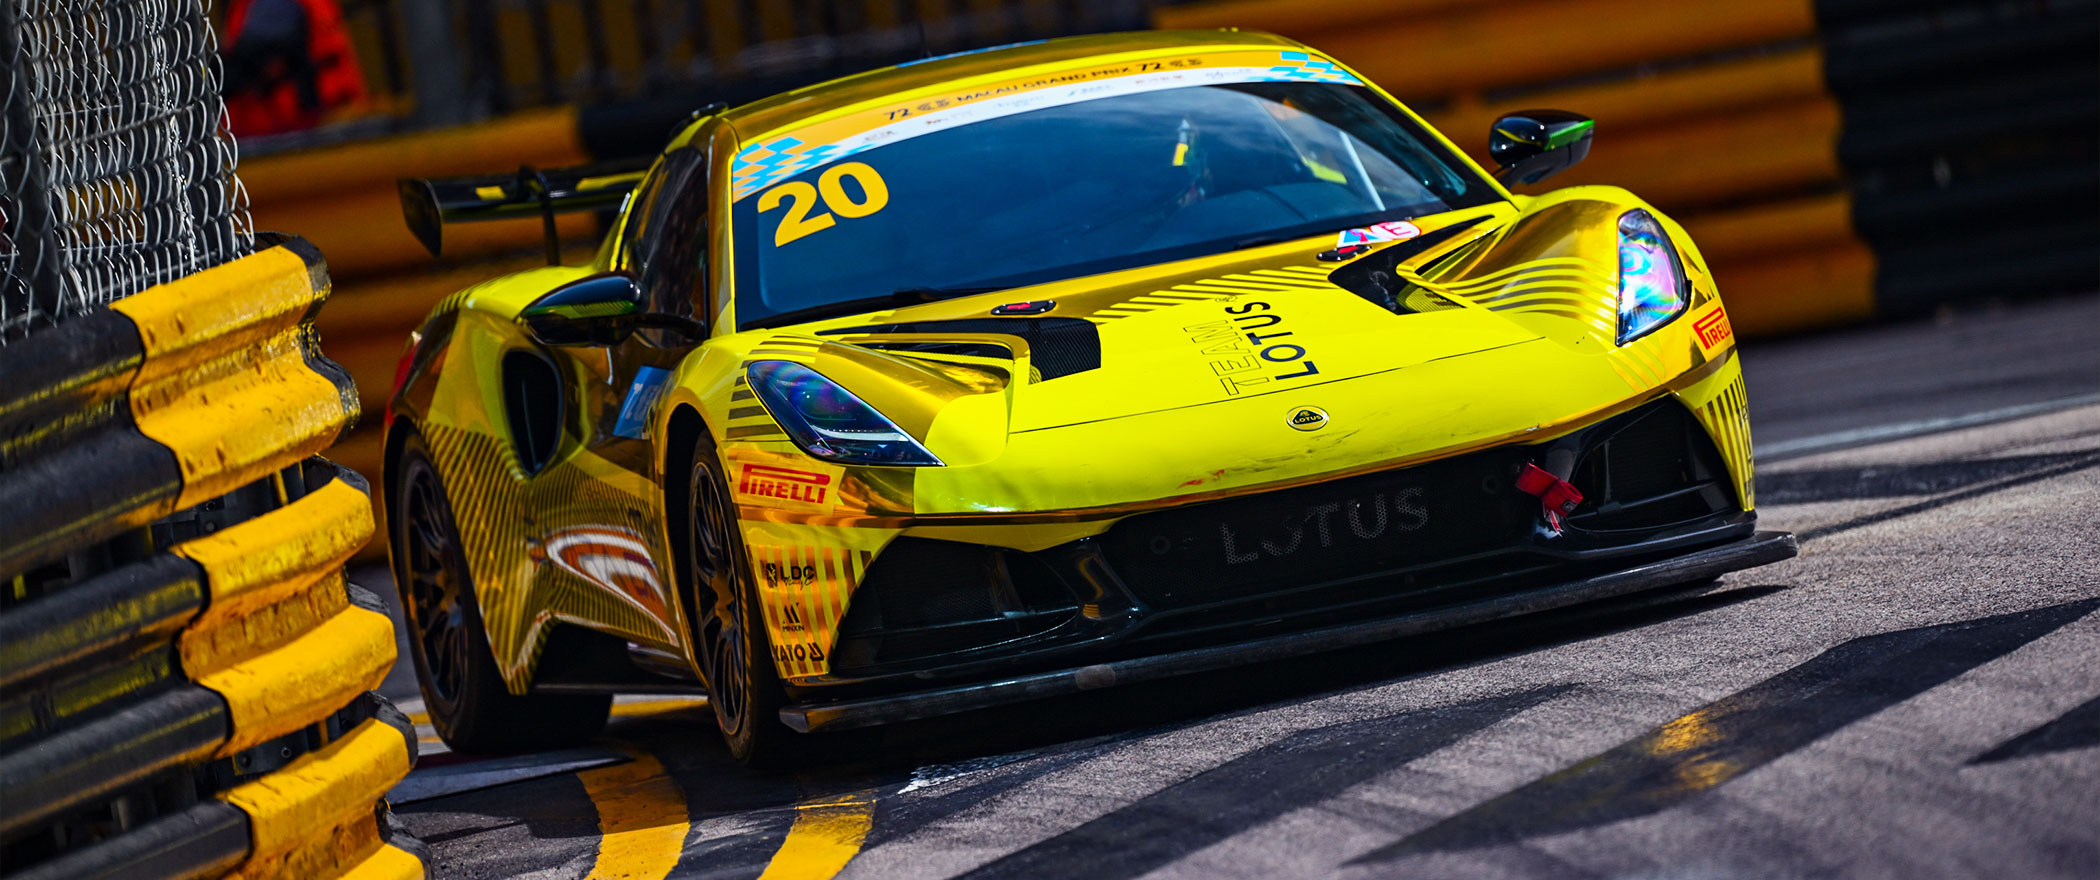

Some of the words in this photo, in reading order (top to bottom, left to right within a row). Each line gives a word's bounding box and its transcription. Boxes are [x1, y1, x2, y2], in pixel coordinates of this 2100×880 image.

[884, 107, 913, 121] 72
[956, 85, 1018, 101] MACAU
[1023, 73, 1086, 88] GRAND
[1091, 67, 1130, 77] PRIX
[1138, 62, 1162, 71] 72
[757, 162, 889, 247] 20
[1183, 320, 1270, 396] TEAM
[1224, 302, 1320, 380] LOTUS
[1294, 415, 1322, 424] LOTUS
[739, 463, 831, 504] PIRELLI
[780, 565, 815, 580] LDC
